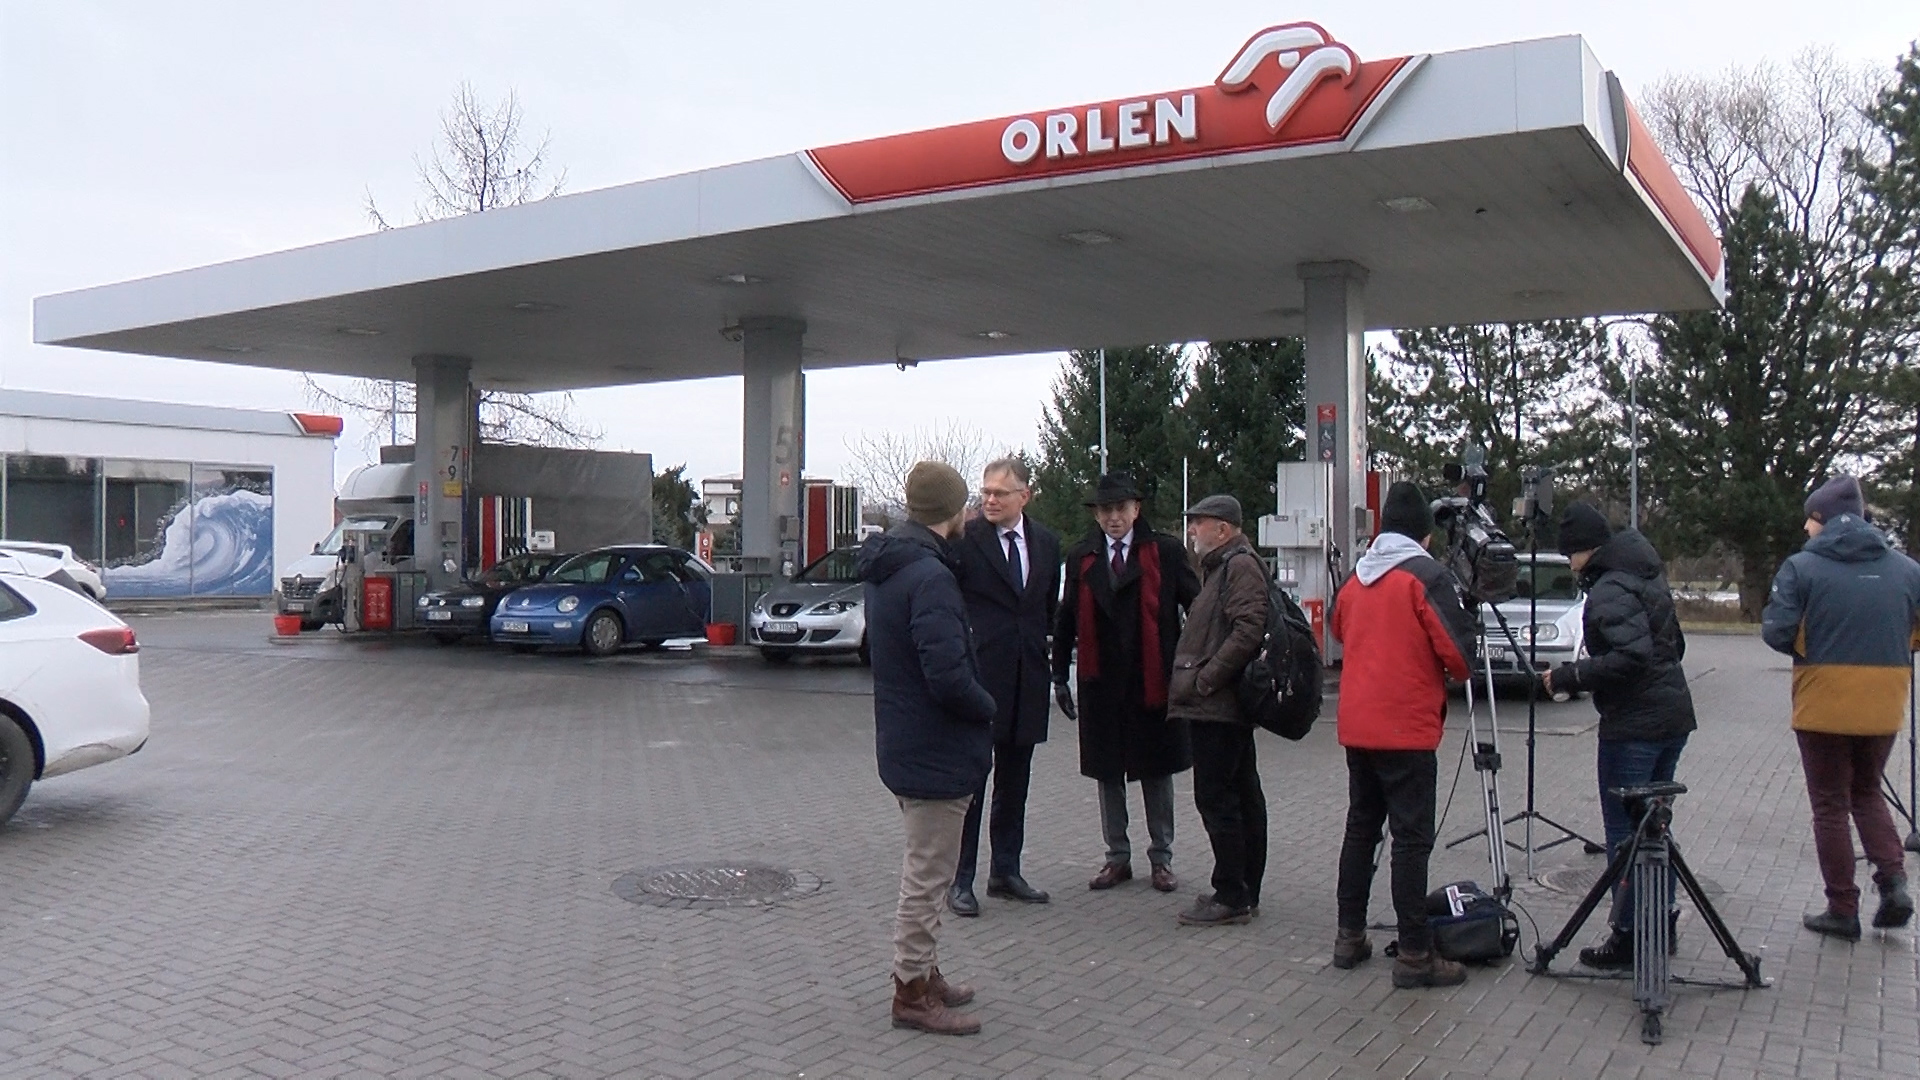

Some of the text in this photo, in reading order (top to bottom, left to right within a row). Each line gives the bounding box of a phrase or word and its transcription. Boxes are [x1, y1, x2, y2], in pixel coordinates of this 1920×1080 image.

[1001, 94, 1197, 163] ORLEN
[450, 445, 460, 462] 7
[775, 425, 792, 464] 5
[448, 465, 457, 482] 9
